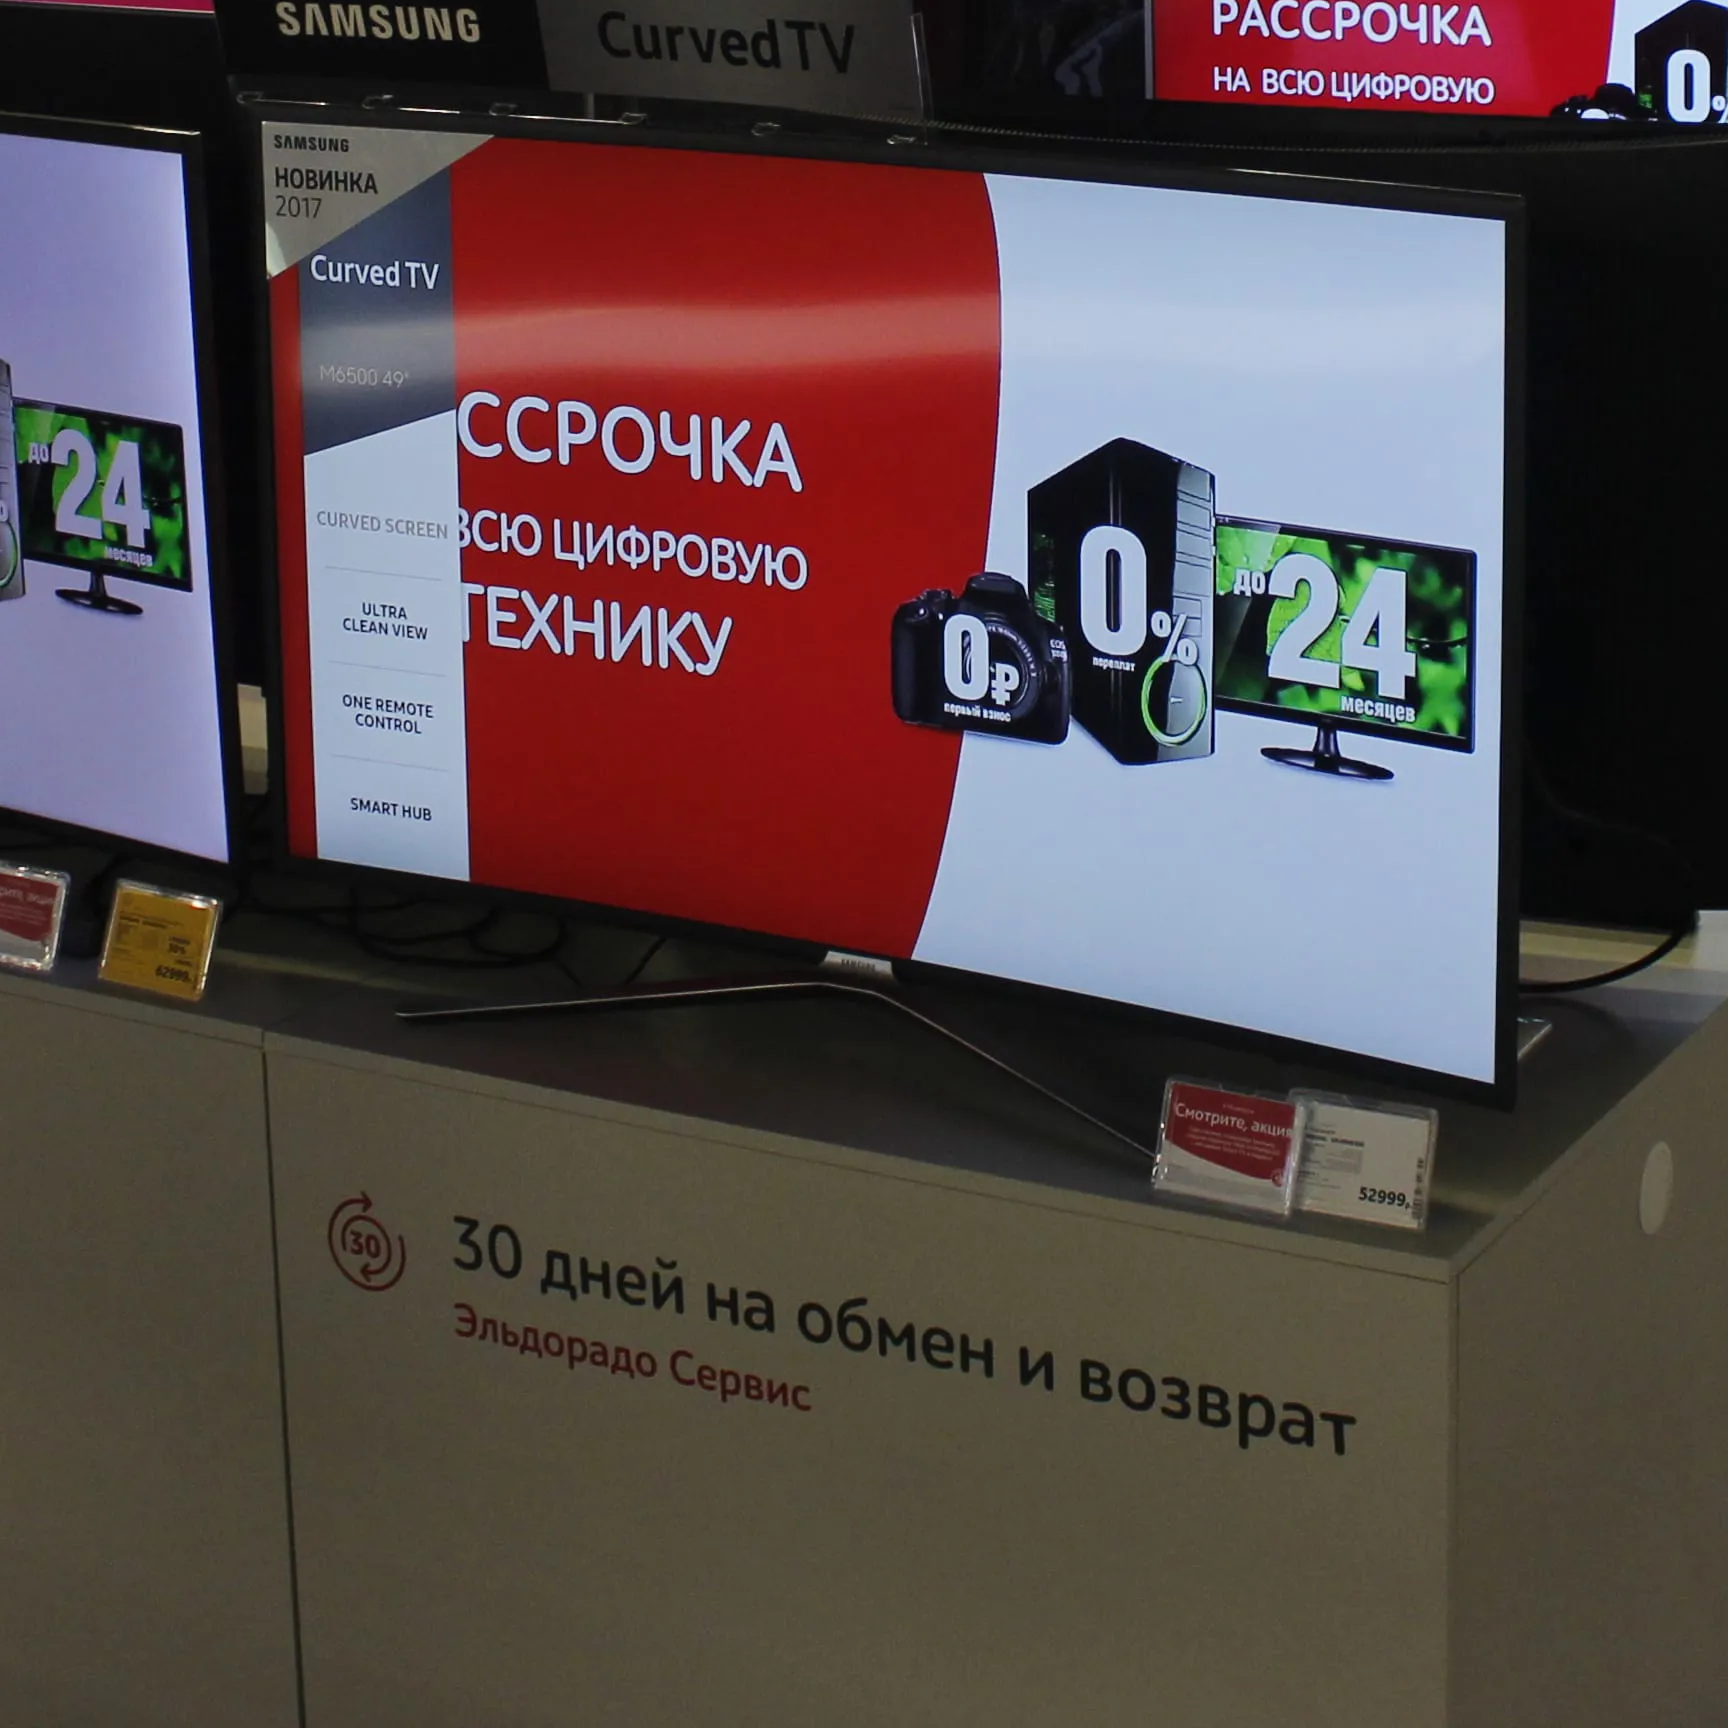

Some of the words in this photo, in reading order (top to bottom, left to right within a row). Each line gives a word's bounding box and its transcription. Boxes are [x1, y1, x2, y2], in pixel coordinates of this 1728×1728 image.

[275, 0, 481, 44] SAMSUNG
[1213, 67, 1251, 93] НА
[1261, 68, 1325, 98] ВСЮ
[1329, 71, 1496, 105] ЦИФРОВУЮ
[273, 133, 350, 154] SAMSUNG
[274, 166, 379, 196] НОВИНКА
[274, 194, 323, 220] 2017
[309, 254, 401, 288] Curved
[404, 261, 440, 291] TV
[318, 363, 378, 387] M6500
[456, 389, 805, 494] ССРОЧКА
[28, 441, 50, 464] до
[50, 427, 151, 549] 24
[316, 509, 382, 535] CURVED
[384, 517, 449, 540] SCREEN
[552, 517, 809, 591] ЦИФРОВУЮ
[361, 601, 409, 621] ULTRA
[1233, 568, 1266, 598] до
[1266, 553, 1417, 700] 24
[342, 616, 389, 637] CLEAN
[391, 623, 429, 641] VIEW
[459, 580, 733, 677] ТЕХНИКУ
[342, 693, 373, 712] ONE
[374, 698, 435, 720] REMOTE
[1339, 693, 1417, 725] месяцев
[354, 713, 423, 735] CONTROL
[349, 796, 399, 818] SMART
[401, 803, 433, 822] HUB
[1174, 1101, 1248, 1133] Смотрите,
[348, 1231, 382, 1262] 30
[452, 1215, 523, 1279] 30
[540, 1248, 685, 1315] дней
[706, 1282, 775, 1333] на
[797, 1297, 995, 1378] обмен
[1018, 1346, 1055, 1392] и
[1079, 1358, 1358, 1456] возврат
[453, 1303, 658, 1379] Эльдорадо
[668, 1350, 813, 1411] Сервис
